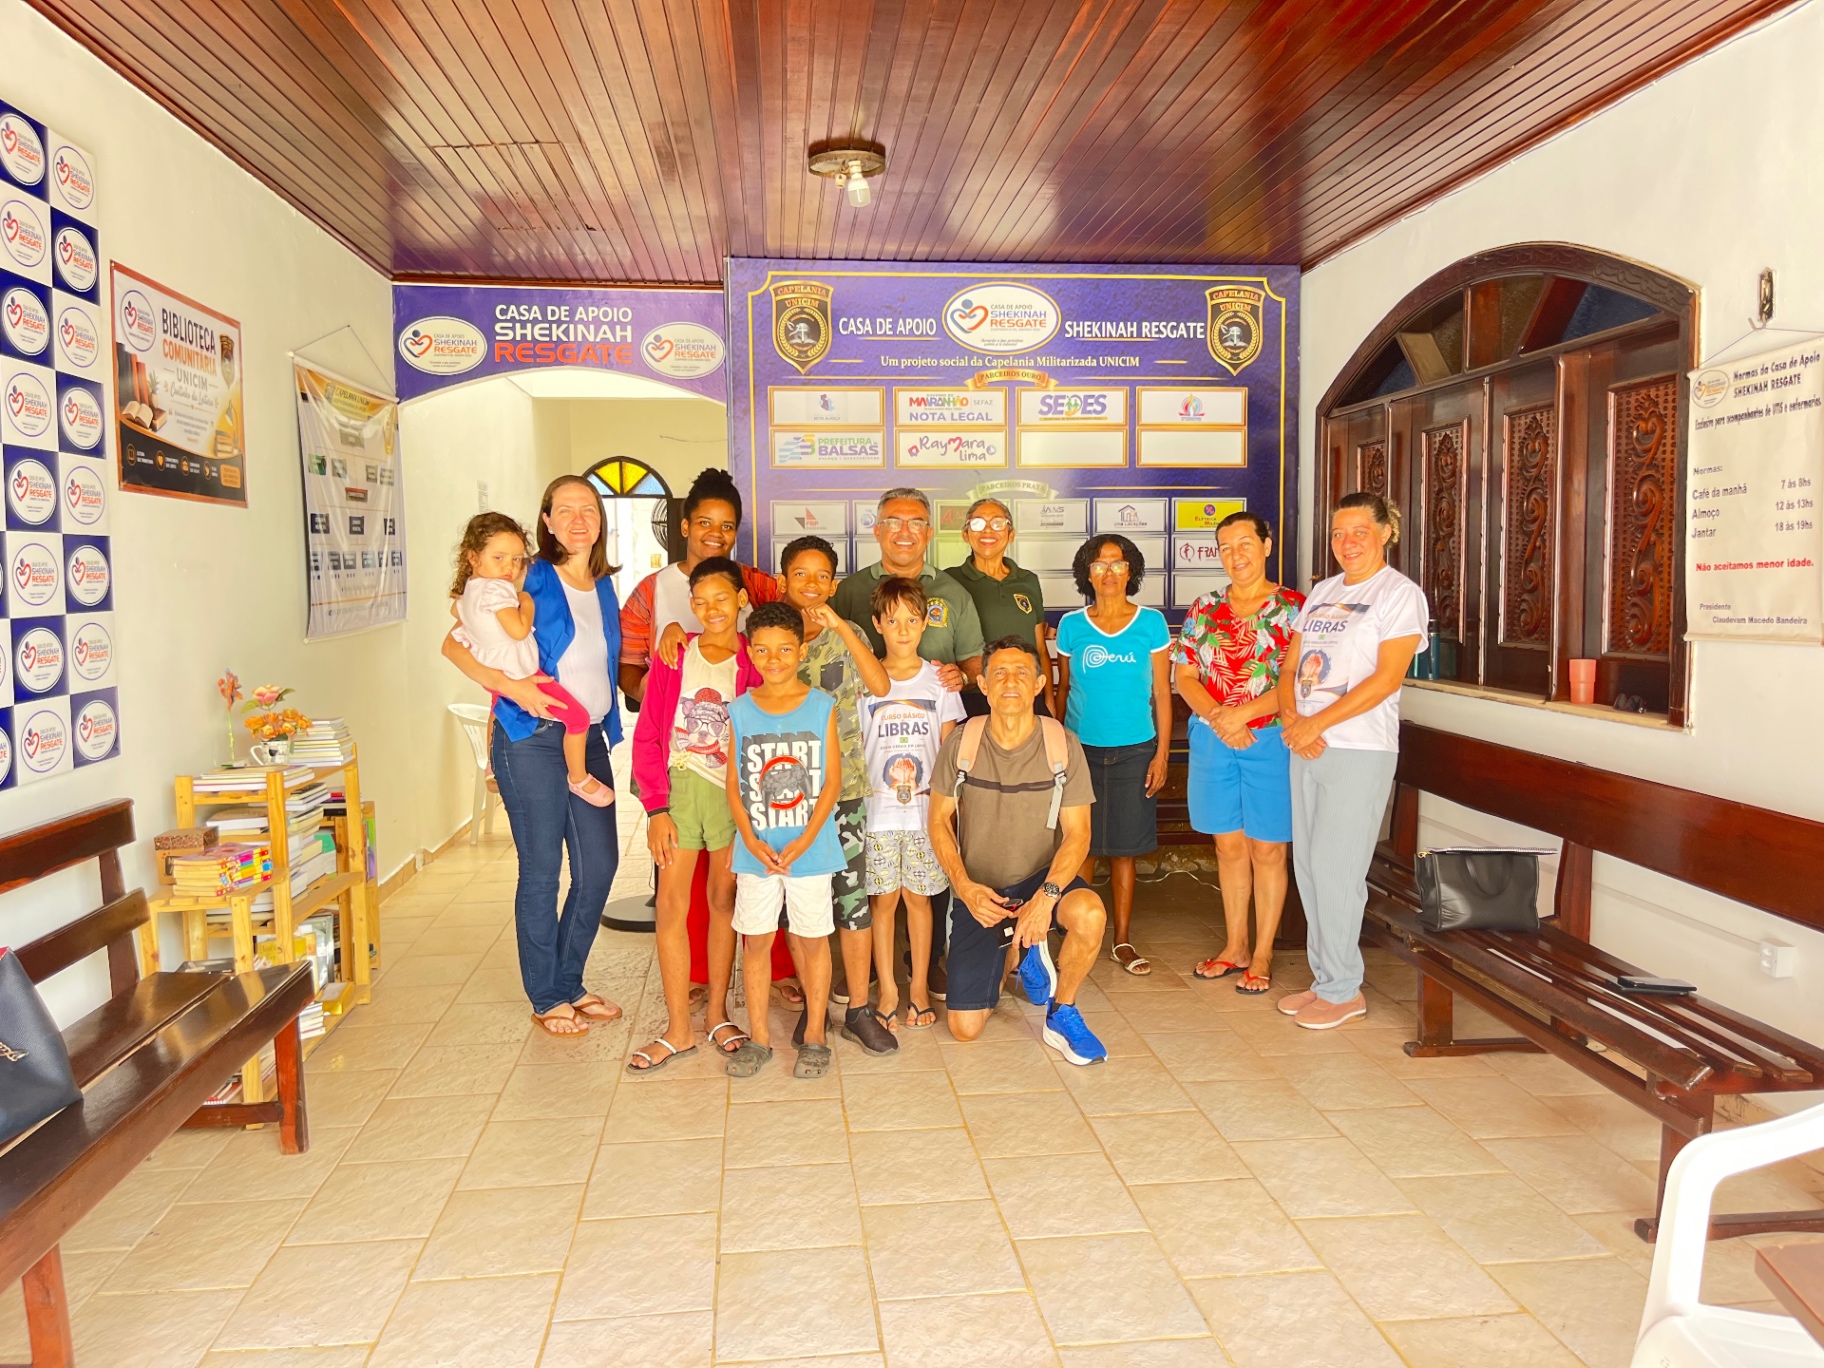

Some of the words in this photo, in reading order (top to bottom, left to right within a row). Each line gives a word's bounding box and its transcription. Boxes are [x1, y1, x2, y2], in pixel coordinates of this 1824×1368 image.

[778, 286, 826, 294] CAPELANIA
[1213, 290, 1258, 300] CAPELANIA
[785, 299, 819, 308] UNICIM
[1220, 302, 1251, 311] UNICIM
[496, 304, 542, 321] CASA
[547, 306, 568, 321] DE
[575, 307, 632, 322] APOIO
[839, 318, 872, 334] CASA
[876, 318, 893, 334] DE
[896, 318, 936, 335] APOIO
[990, 319, 1046, 327] RESGATE
[1065, 321, 1137, 338] SHEKINAH
[1142, 322, 1205, 338] RESGATE
[162, 308, 216, 355] BIBLIOTECA
[496, 323, 632, 342] SHEKINAH
[496, 343, 632, 364] RESGATE
[881, 356, 898, 366] Um
[901, 356, 938, 368] projeto
[940, 356, 968, 366] social
[970, 356, 982, 366] da
[985, 356, 1032, 369] Capelania
[1036, 356, 1096, 366] Militarizada
[1099, 357, 1140, 366] UNICIM
[1733, 368, 1758, 382] Normas
[1760, 364, 1768, 376] da
[1771, 361, 1786, 373] Casa
[1789, 356, 1797, 368] de
[1800, 350, 1820, 368] Apoio
[176, 367, 208, 391] UNICIM
[980, 371, 1020, 380] PARCEIROS
[1022, 371, 1042, 380] OURO
[1734, 382, 1768, 398] SHEKINAH
[1771, 373, 1801, 390] RESGATE
[909, 396, 968, 406] MARANHÃO
[25, 406, 48, 417] RESGATE
[910, 412, 946, 421] NOTA
[951, 412, 992, 421] LEGAL
[1715, 418, 1725, 429] para
[1727, 408, 1763, 424] acompanhantes
[1765, 404, 1771, 416] de
[819, 446, 878, 456] BALSAS
[1693, 465, 1723, 476] Normas:
[29, 489, 52, 498] RESGATE
[981, 482, 1020, 492] PARCEIROS
[1022, 482, 1045, 491] PRATA
[1692, 488, 1710, 500] Café
[1712, 487, 1720, 497] da
[1722, 483, 1747, 496] manhã
[1781, 480, 1786, 489] 7
[1788, 479, 1796, 488] às
[1798, 478, 1811, 487] 8hs
[1692, 508, 1720, 520] Almoço
[1776, 501, 1784, 510] 12
[1786, 500, 1795, 510] às
[1797, 499, 1814, 508] 13hs
[1692, 527, 1716, 538] Jantar
[1775, 522, 1784, 532] 18
[1786, 521, 1794, 530] às
[1796, 520, 1812, 530] 19hs
[1696, 562, 1711, 572] Não
[1714, 561, 1754, 570] aceitamos
[1756, 560, 1784, 569] menor
[1787, 558, 1814, 568] idade.
[1303, 620, 1348, 633] LIBRAS
[1776, 616, 1808, 624] Bandeira
[37, 655, 59, 664] RESGATE
[1082, 645, 1136, 674] Perú
[878, 722, 928, 738] LIBRAS
[40, 738, 62, 750] RESGATE
[747, 740, 822, 773] START
